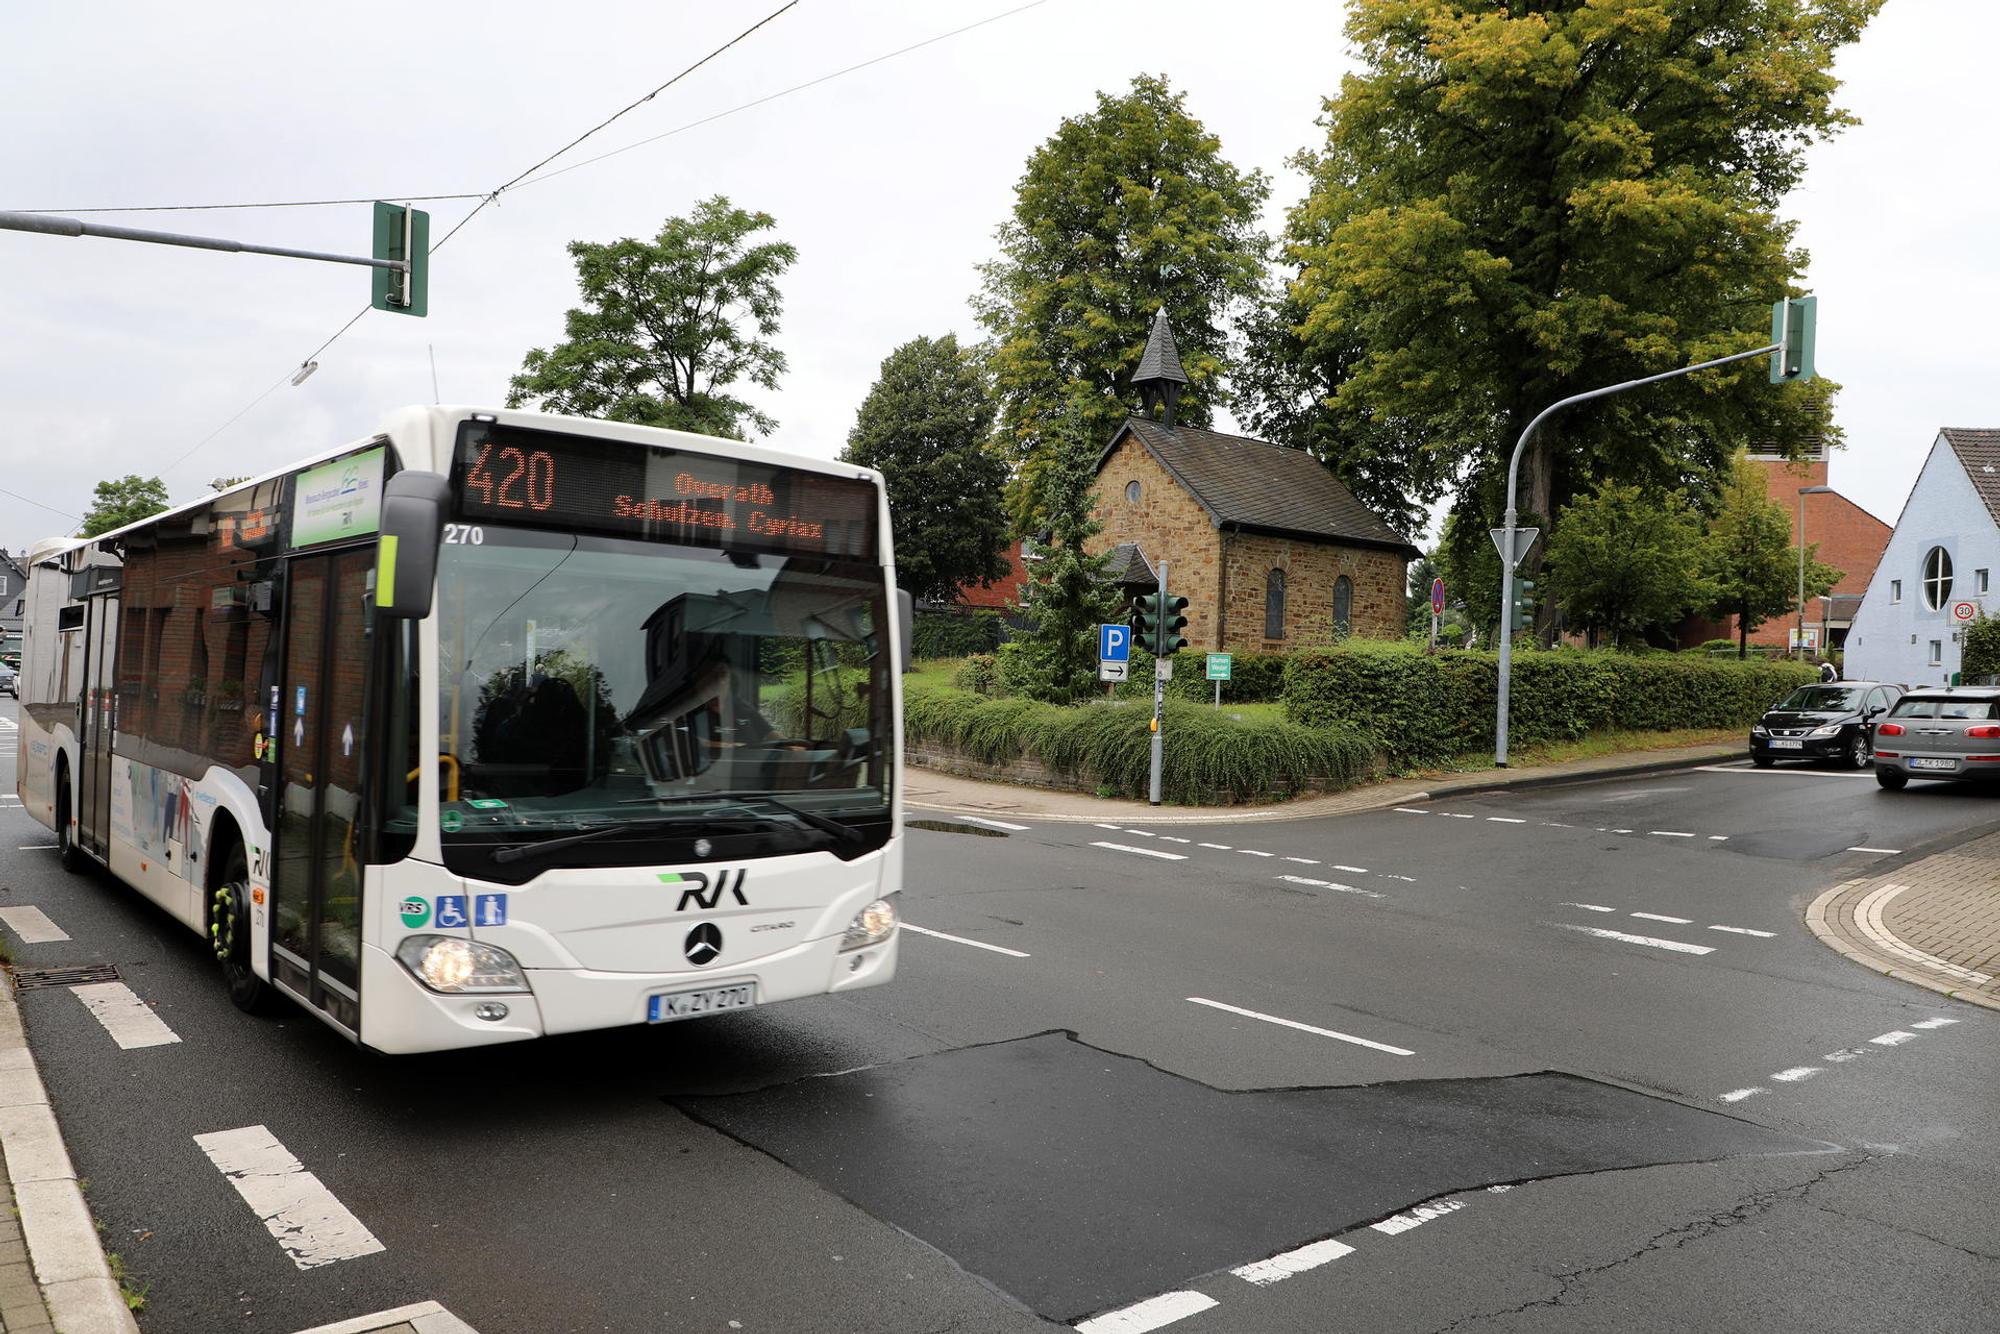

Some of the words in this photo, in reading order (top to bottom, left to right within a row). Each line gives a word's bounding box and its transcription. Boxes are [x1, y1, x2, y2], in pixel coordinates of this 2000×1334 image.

[466, 443, 555, 511] 420
[673, 471, 775, 505] Overath
[443, 523, 485, 545] 270
[1958, 606, 1971, 616] 30
[1107, 629, 1124, 657] P
[400, 902, 423, 914] VRS
[665, 997, 678, 1016] K
[691, 991, 715, 1013] ZY
[717, 986, 749, 1008] 270
